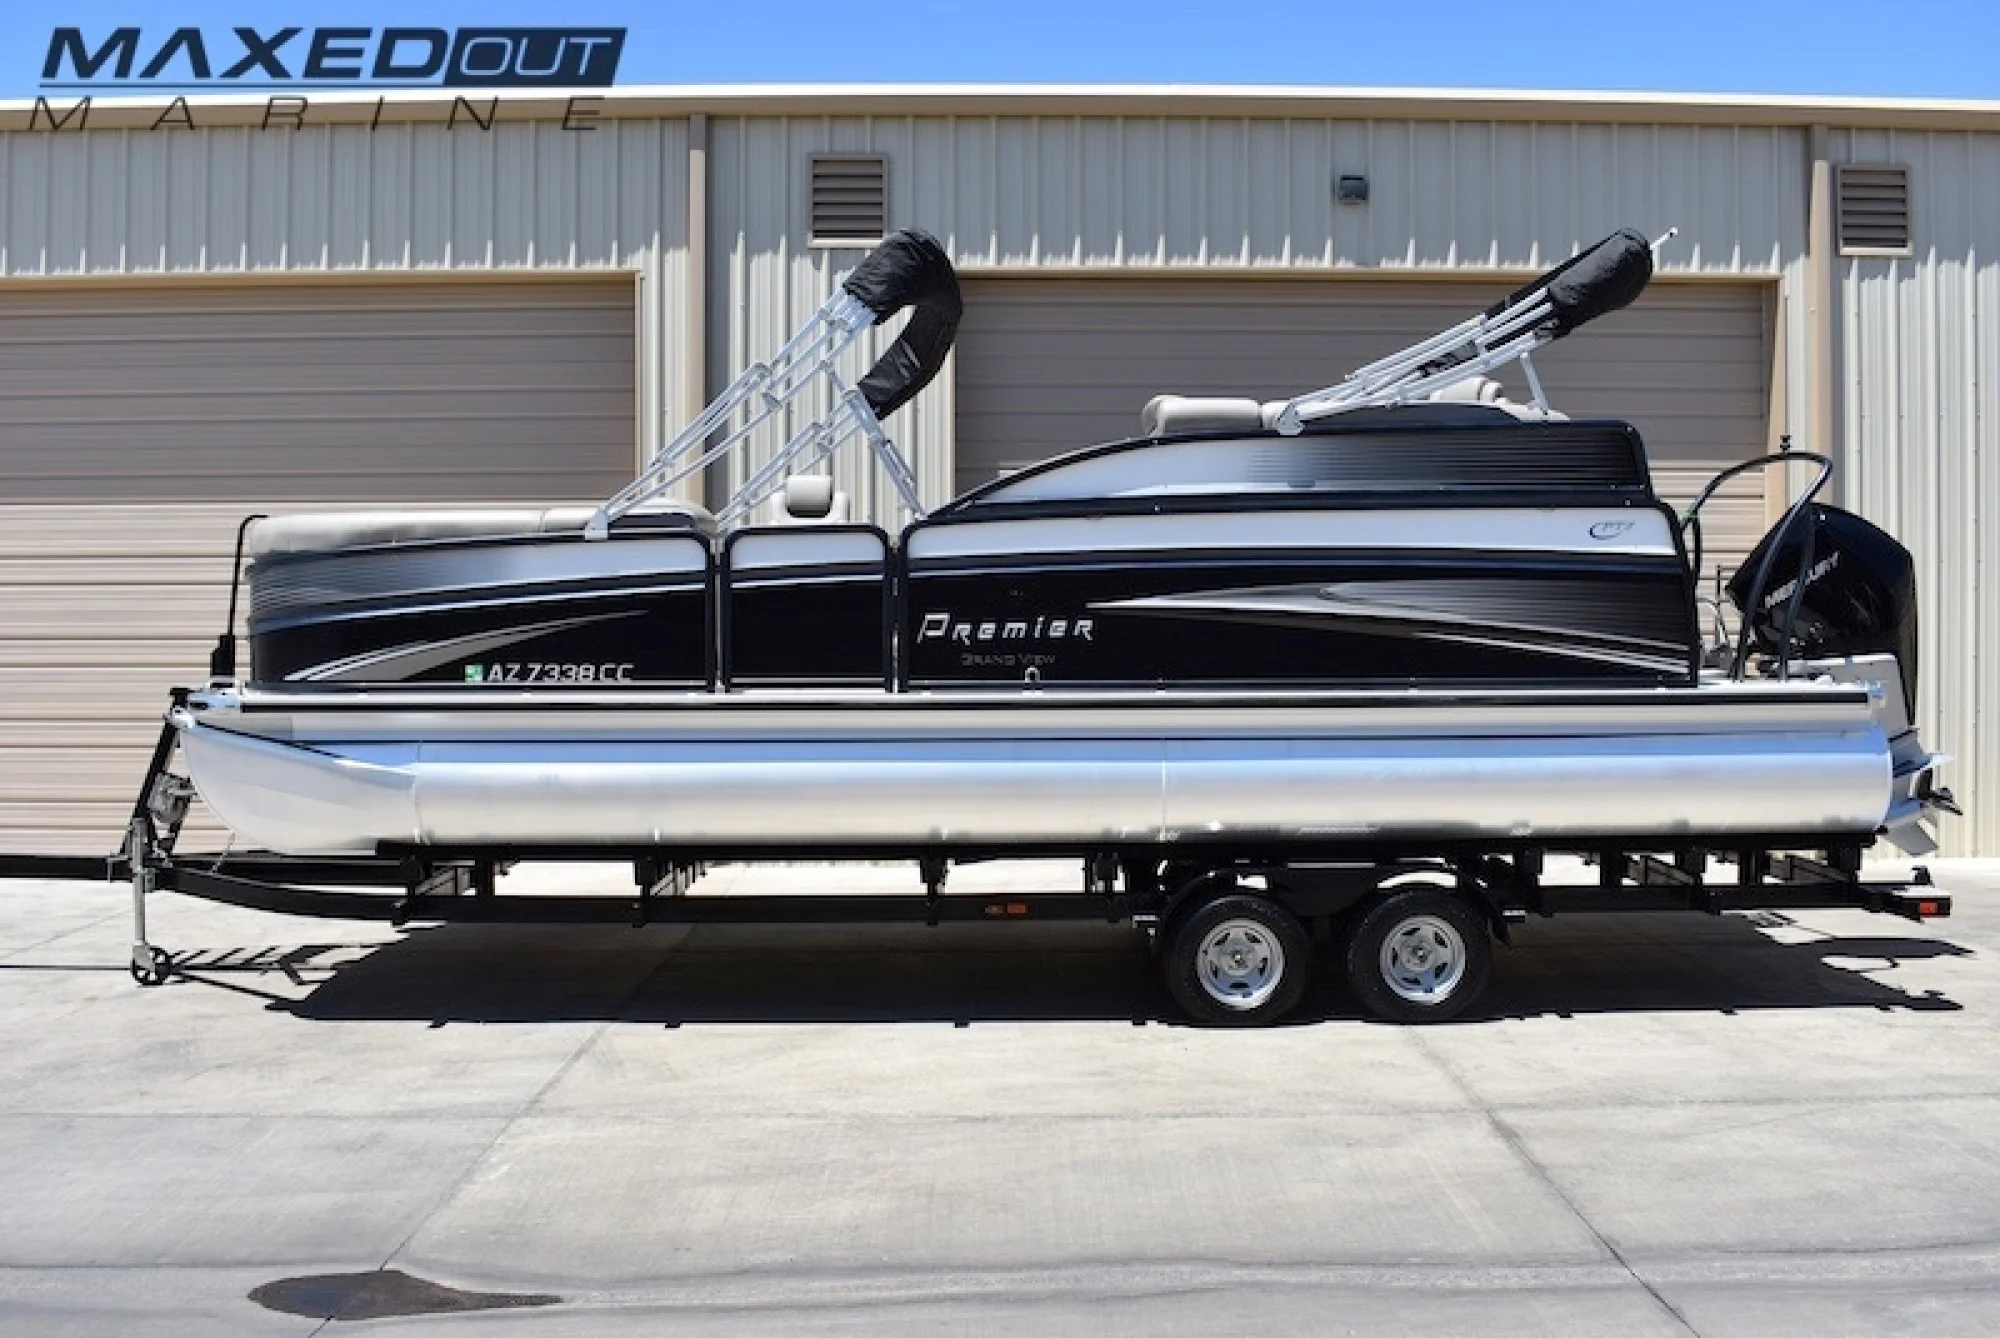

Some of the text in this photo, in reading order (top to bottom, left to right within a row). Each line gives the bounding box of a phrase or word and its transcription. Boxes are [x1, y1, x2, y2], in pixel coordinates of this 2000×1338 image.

[1764, 552, 1839, 609] MERURY
[487, 664, 521, 681] AZ
[599, 664, 634, 682] CC
